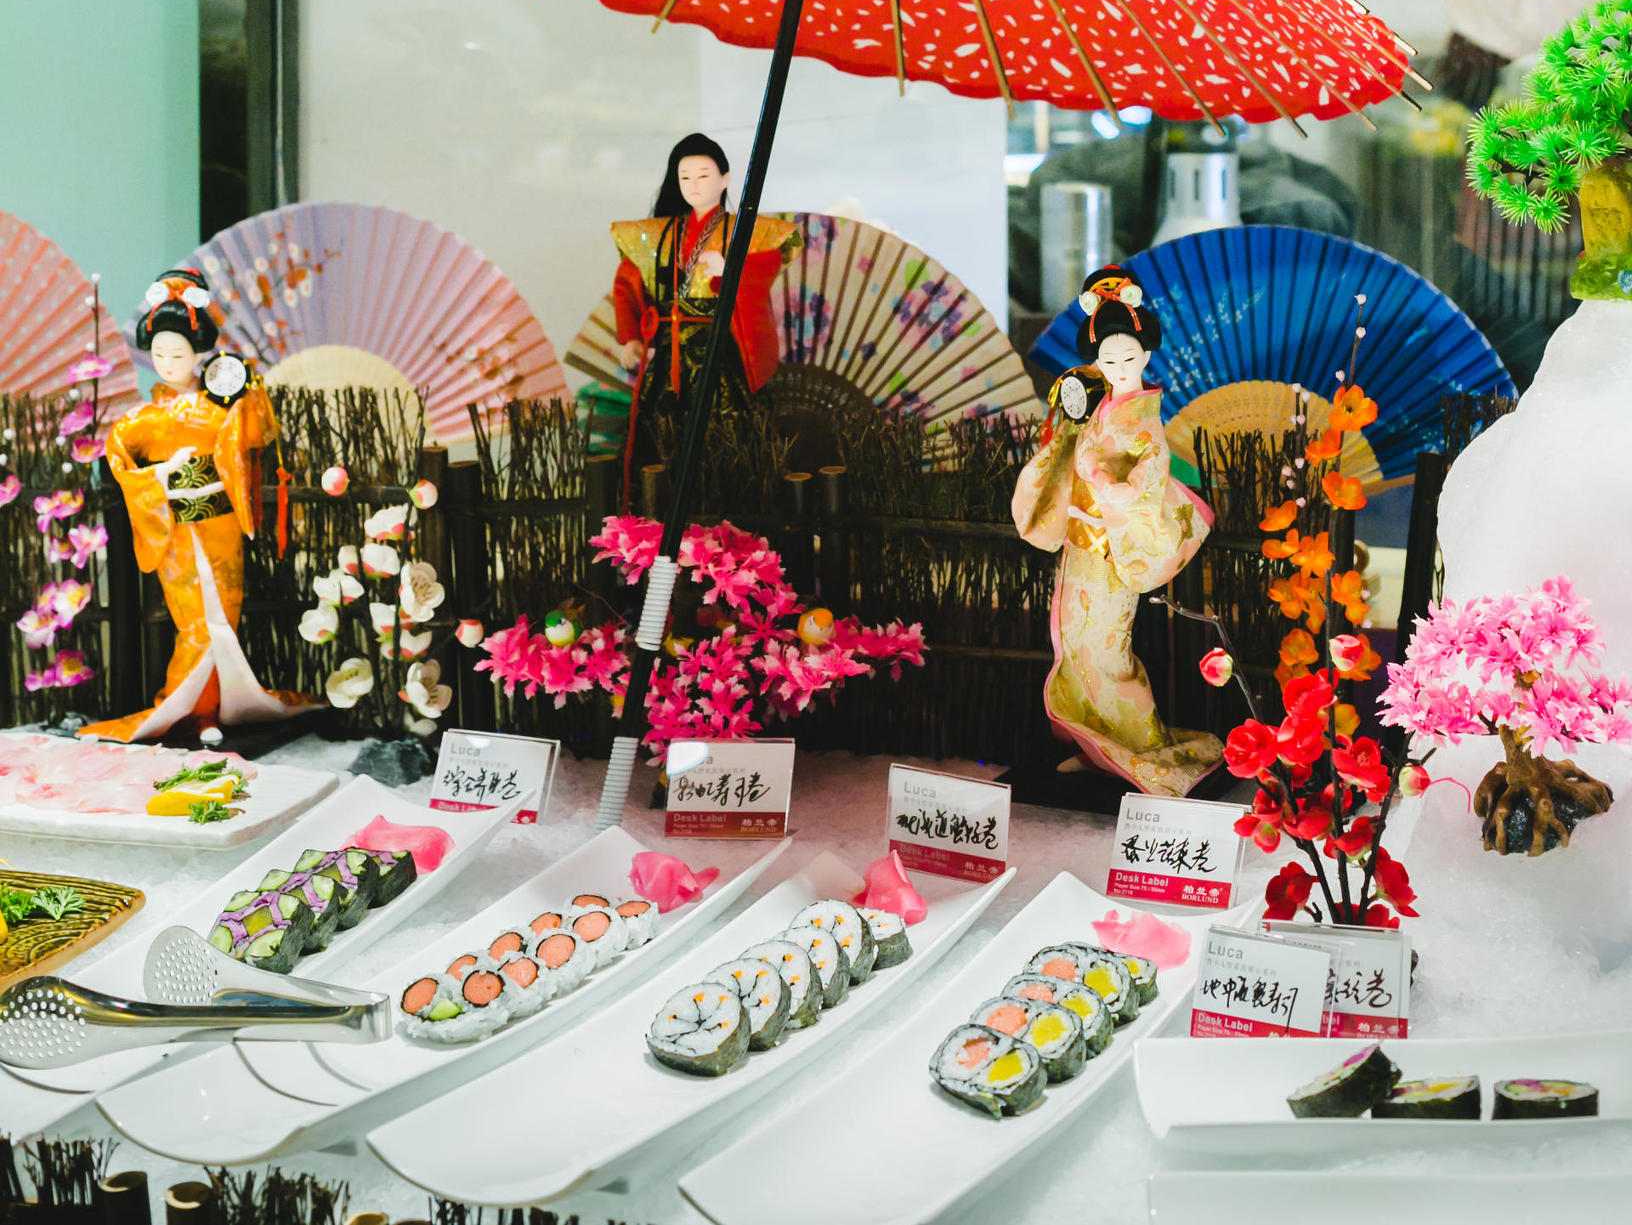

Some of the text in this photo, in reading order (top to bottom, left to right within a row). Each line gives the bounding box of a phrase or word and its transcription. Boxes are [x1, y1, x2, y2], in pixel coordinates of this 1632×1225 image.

[450, 743, 481, 757] Luca
[904, 780, 936, 798] Luca
[673, 813, 727, 822] Desk Label
[1126, 808, 1160, 822] Luca
[1115, 872, 1169, 887] Desk Label
[1181, 893, 1219, 904] BORLUND
[1208, 940, 1244, 959] Luca
[1197, 1012, 1222, 1026] Desk
[1224, 1018, 1253, 1032] Label
